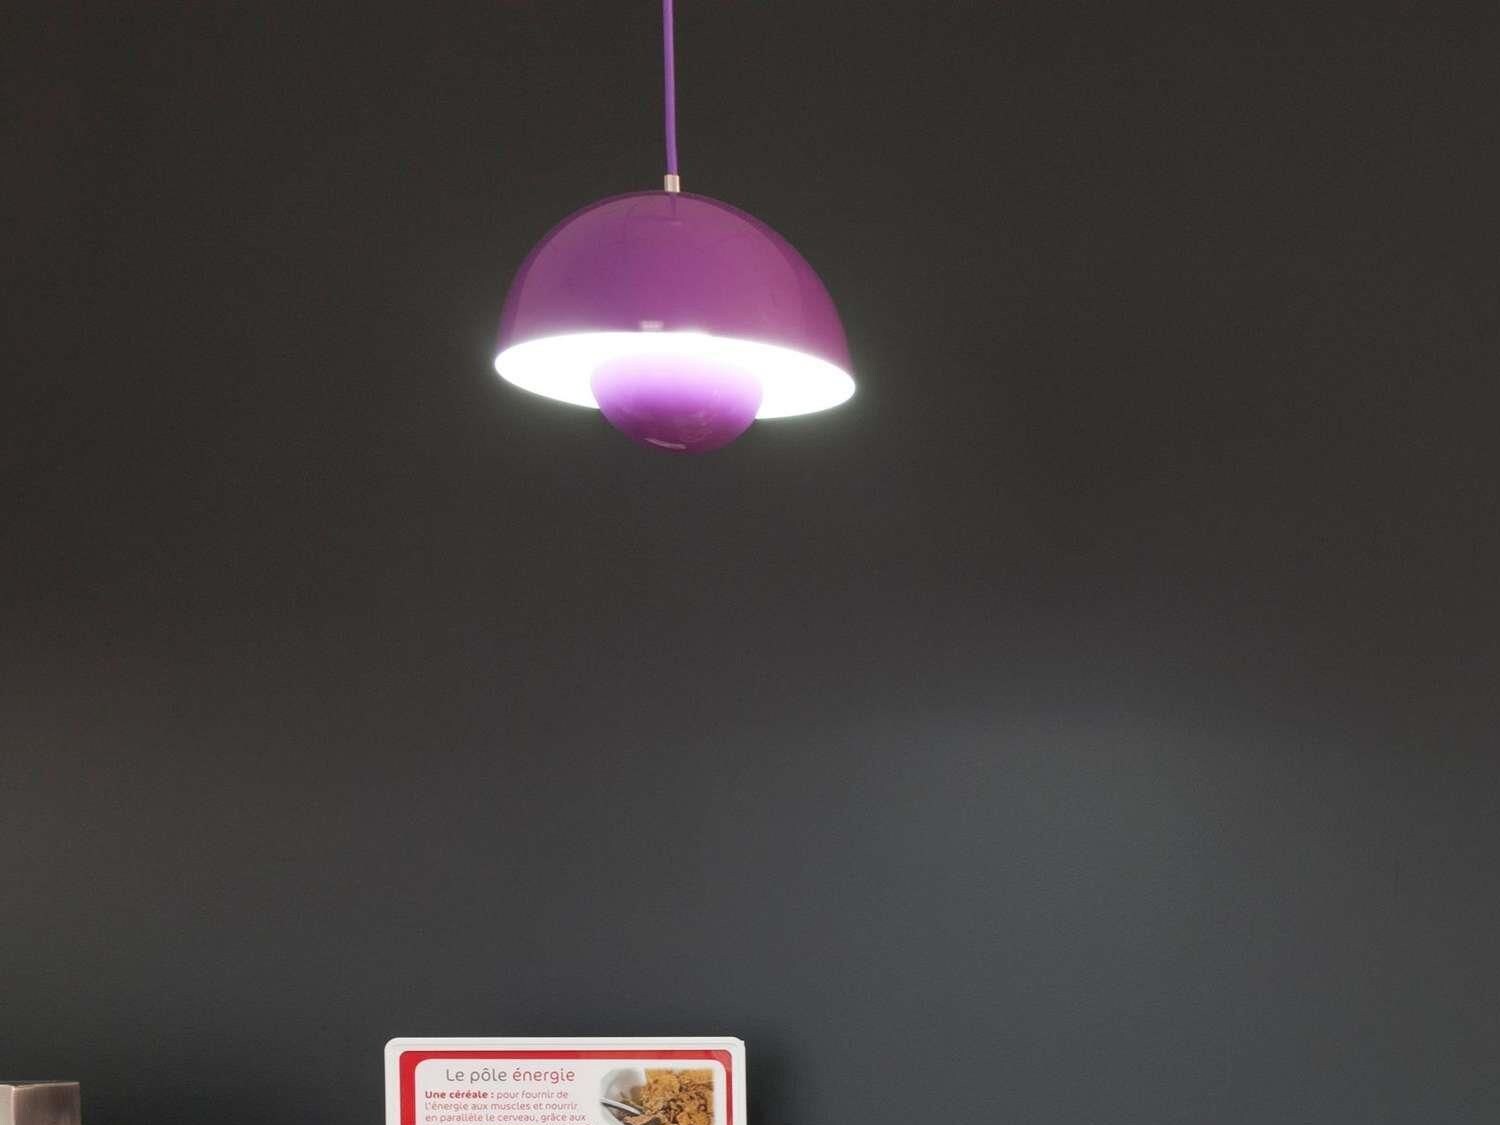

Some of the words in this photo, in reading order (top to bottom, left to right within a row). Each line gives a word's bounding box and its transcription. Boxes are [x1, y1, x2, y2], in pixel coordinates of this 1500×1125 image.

[446, 1068, 465, 1082] Le
[470, 1068, 507, 1083] pôle
[513, 1068, 576, 1083] énergie
[425, 1090, 446, 1099] Une
[449, 1090, 488, 1099] céréale
[497, 1092, 518, 1101] pour
[521, 1090, 554, 1099] fournir
[556, 1090, 569, 1099] de
[425, 1101, 468, 1111] l'énergie
[490, 1102, 531, 1110] muscles
[533, 1102, 543, 1110] et
[545, 1102, 578, 1110] nourrir
[440, 1113, 483, 1123] parallèle
[485, 1113, 495, 1122] le
[540, 1113, 567, 1123] grâce
